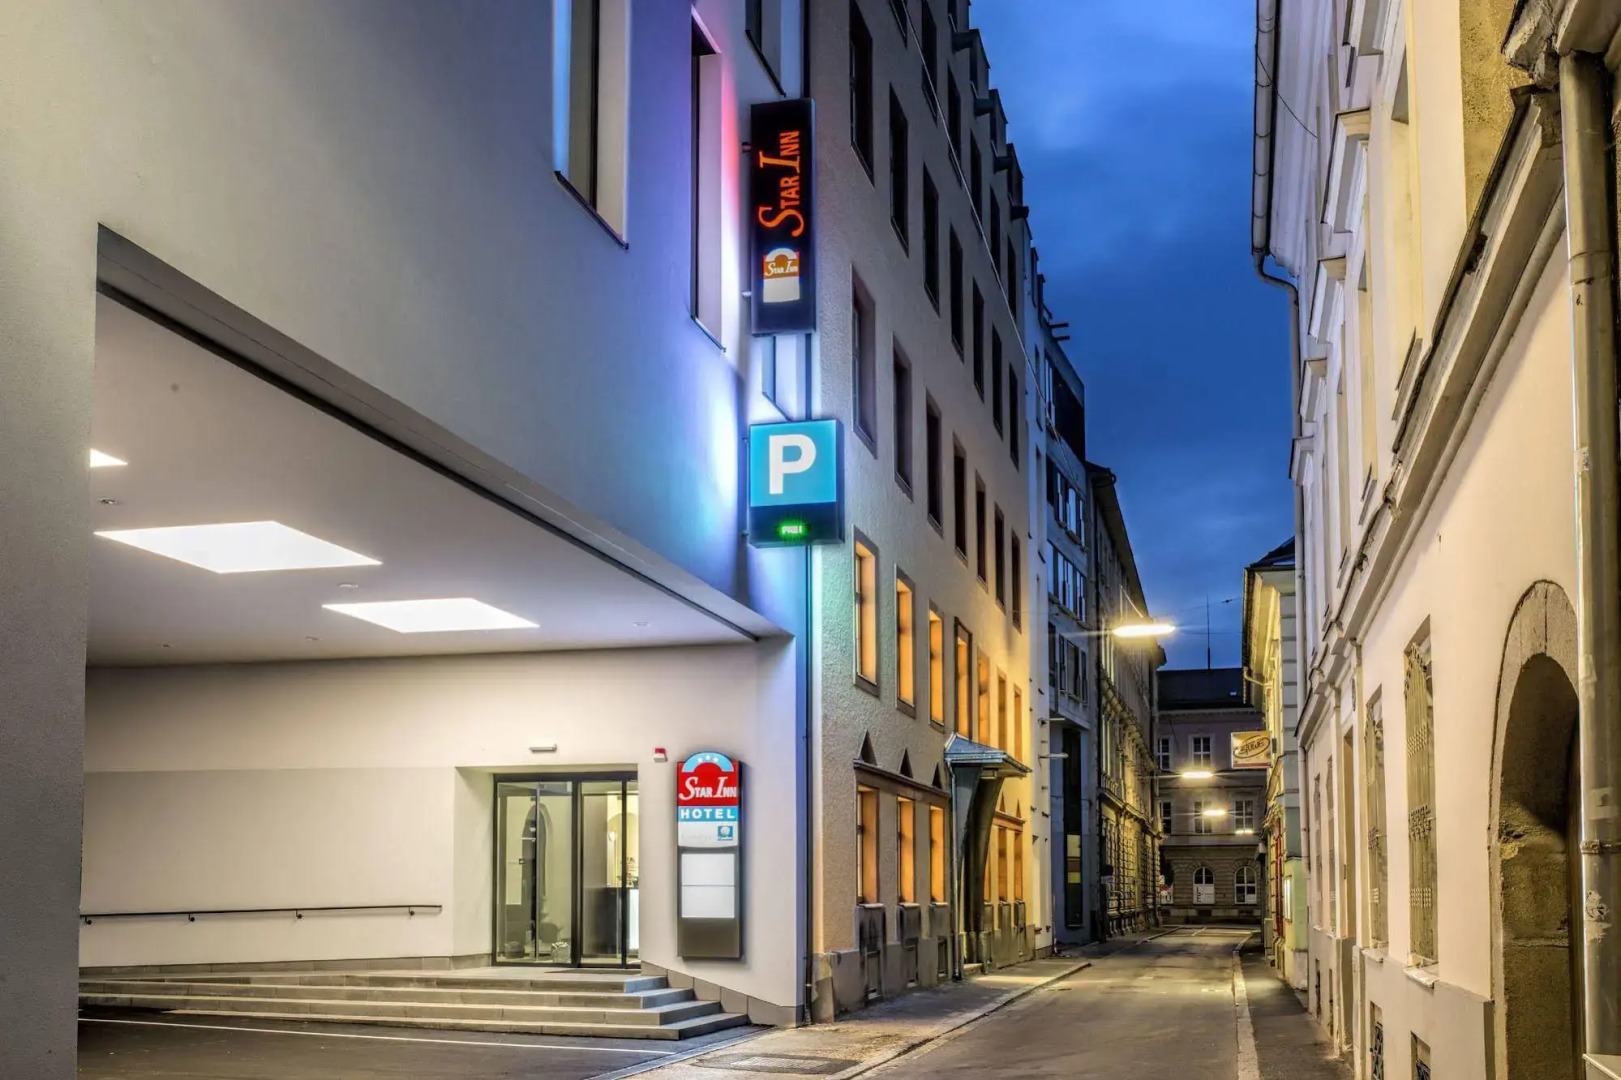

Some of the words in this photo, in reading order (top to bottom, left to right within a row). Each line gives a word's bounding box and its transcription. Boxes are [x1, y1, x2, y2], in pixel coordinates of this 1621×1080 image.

[759, 131, 800, 174] INN
[758, 175, 804, 237] STAR
[769, 434, 817, 495] P
[679, 776, 713, 800] STAR
[713, 776, 737, 798] INN
[680, 808, 735, 819] HOTEL
